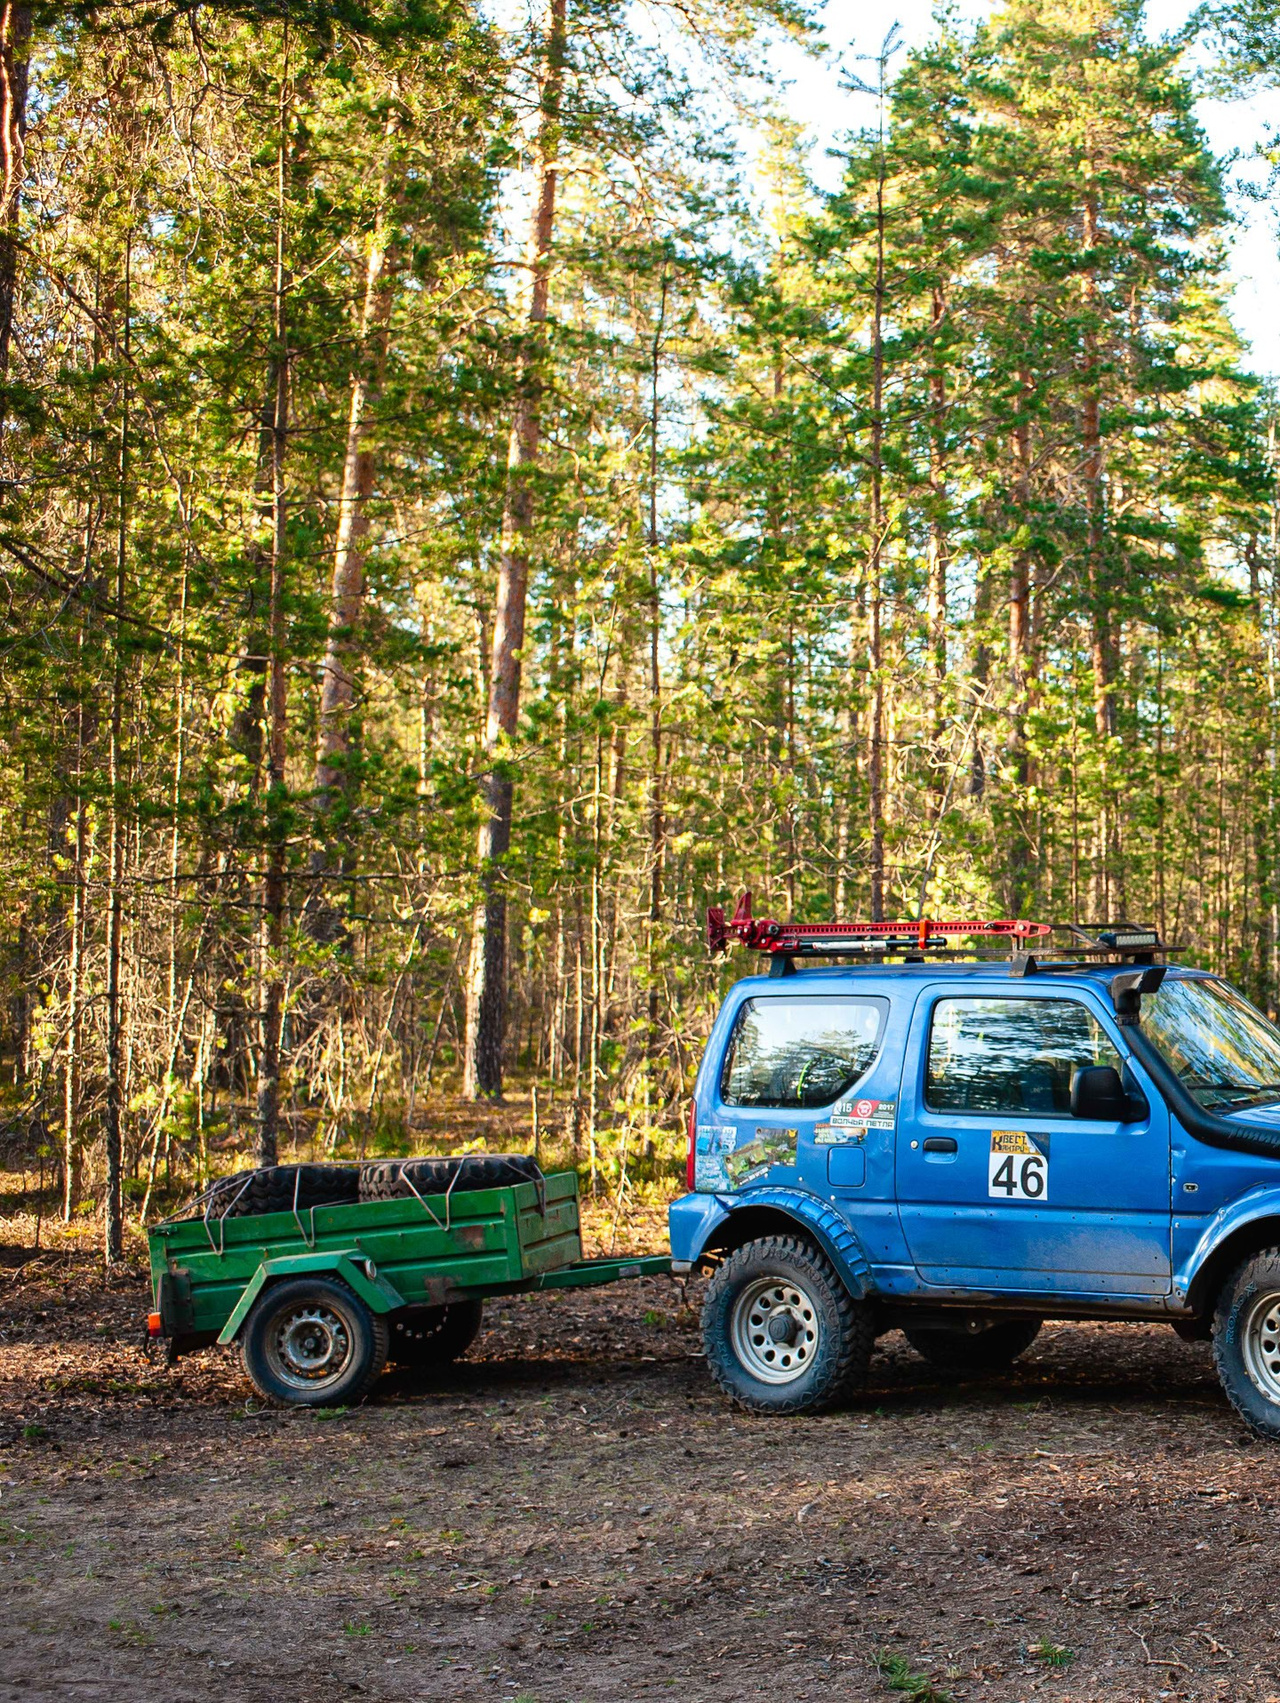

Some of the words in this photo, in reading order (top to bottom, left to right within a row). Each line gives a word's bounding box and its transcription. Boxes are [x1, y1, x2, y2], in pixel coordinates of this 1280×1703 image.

[878, 1103, 895, 1111] 2017
[832, 1117, 864, 1126] ВОЛЧЬЯ
[866, 1119, 893, 1128] ПЕТЛЯ
[992, 1155, 1044, 1198] 46
